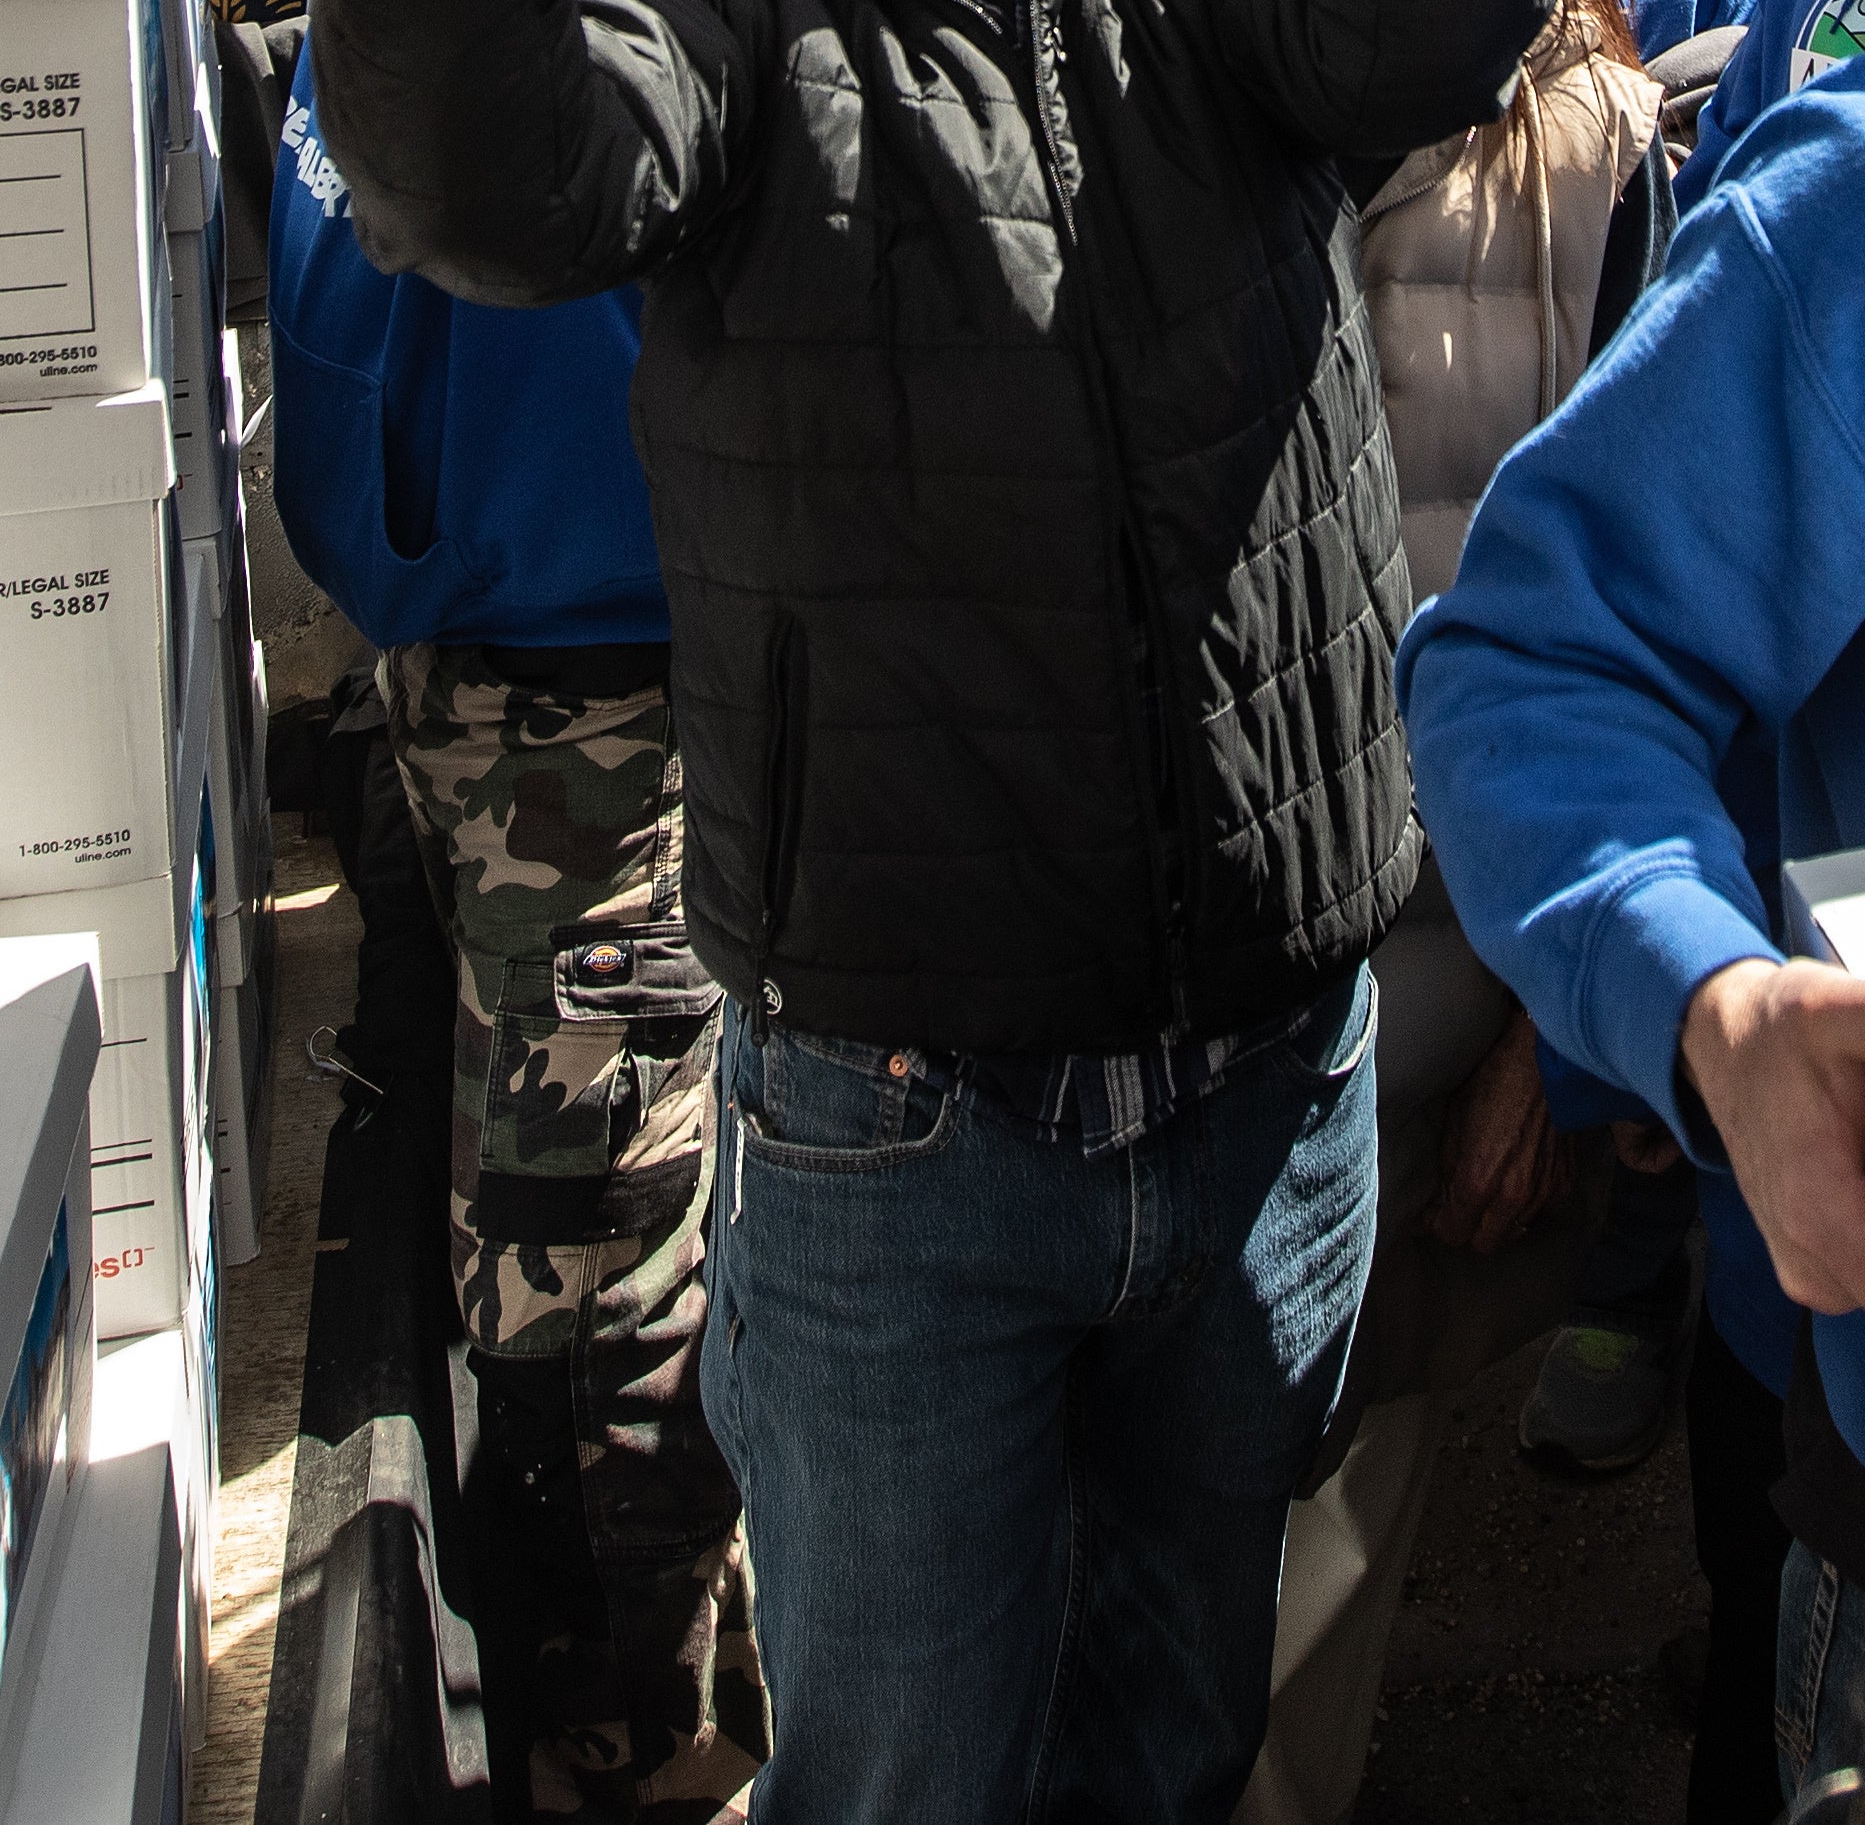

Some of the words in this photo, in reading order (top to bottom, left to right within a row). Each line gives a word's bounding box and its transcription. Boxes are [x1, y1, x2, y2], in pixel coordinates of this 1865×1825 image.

[44, 72, 81, 91] SIZE
[0, 96, 81, 123] S-3887
[39, 361, 98, 378] uline.com
[73, 569, 110, 588] SIZE
[29, 592, 111, 620] S-3887
[18, 829, 132, 858] 1-800-295-5510
[73, 845, 133, 864] uline.com
